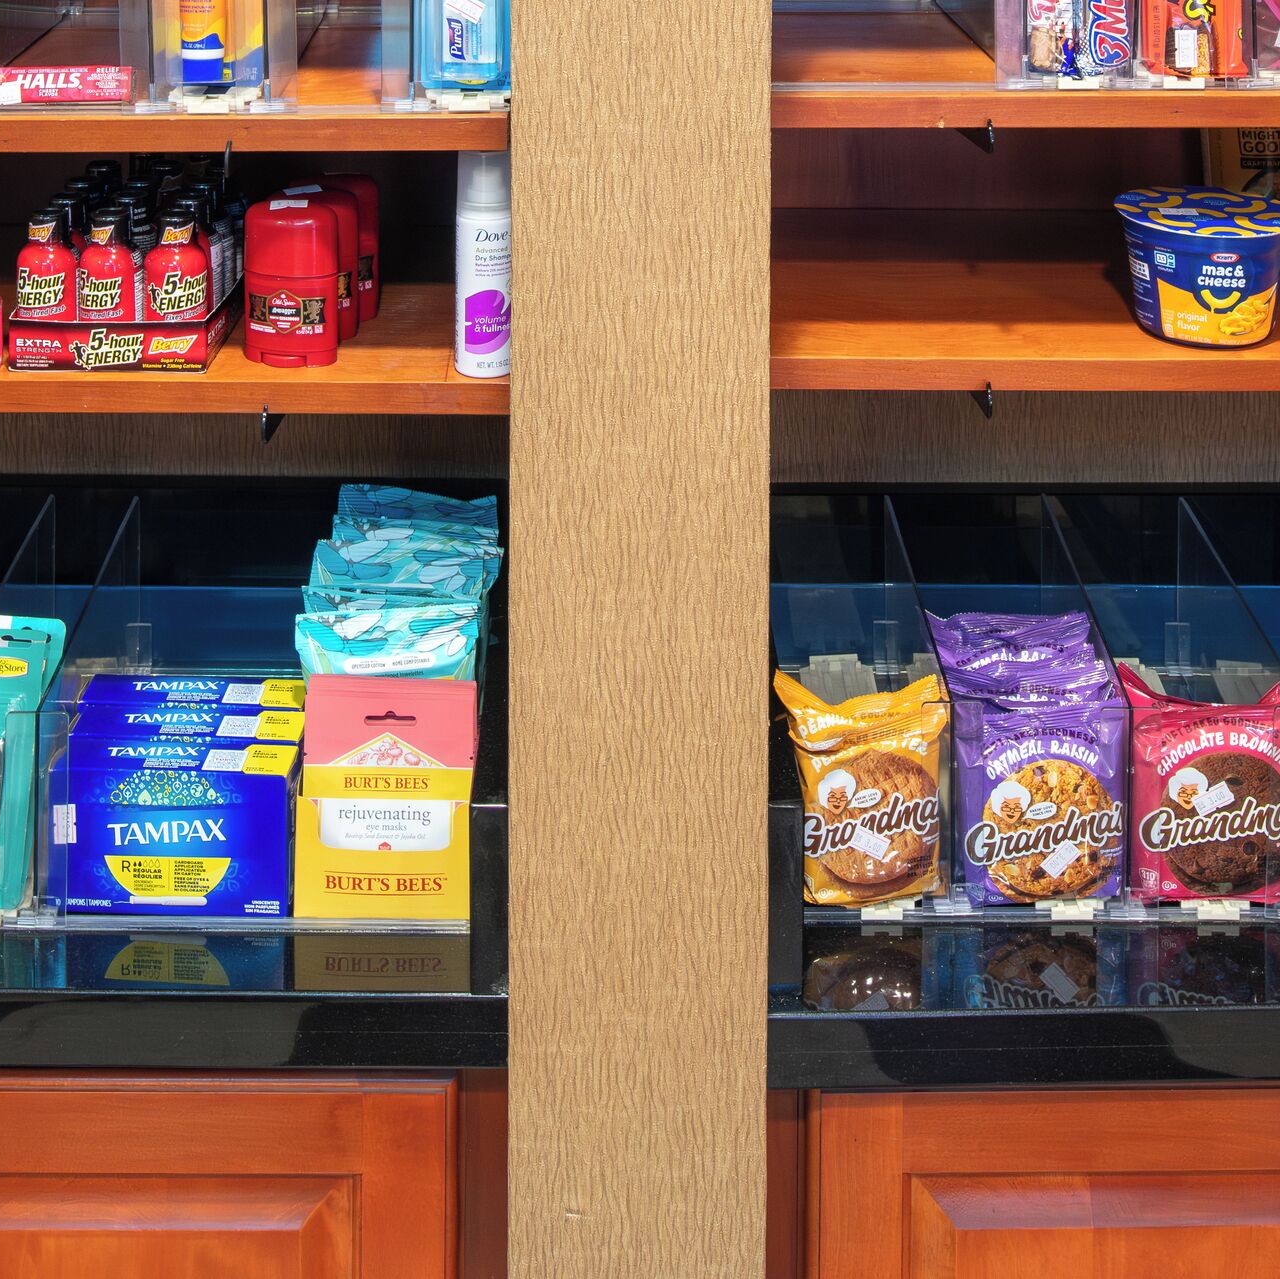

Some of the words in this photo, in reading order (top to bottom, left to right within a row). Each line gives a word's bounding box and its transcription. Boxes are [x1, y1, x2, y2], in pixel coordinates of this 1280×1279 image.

[476, 229, 508, 243] Dove
[1202, 266, 1231, 276] mac
[1234, 266, 1244, 276] &
[1178, 312, 1207, 322] original
[1178, 321, 1200, 331] flavor
[91, 329, 143, 350] 5-hour
[85, 347, 142, 365] ENERGY
[987, 741, 1044, 779] OATMEAL
[1051, 741, 1098, 766] RAISIN
[1158, 733, 1224, 776] CHOCOLATE
[344, 777, 390, 789] BURT'S
[395, 777, 429, 789] BEES
[339, 804, 431, 825] rejuvenating
[107, 819, 227, 846] TAMPAX
[326, 875, 390, 891] BURT'S
[396, 878, 442, 891] BEES
